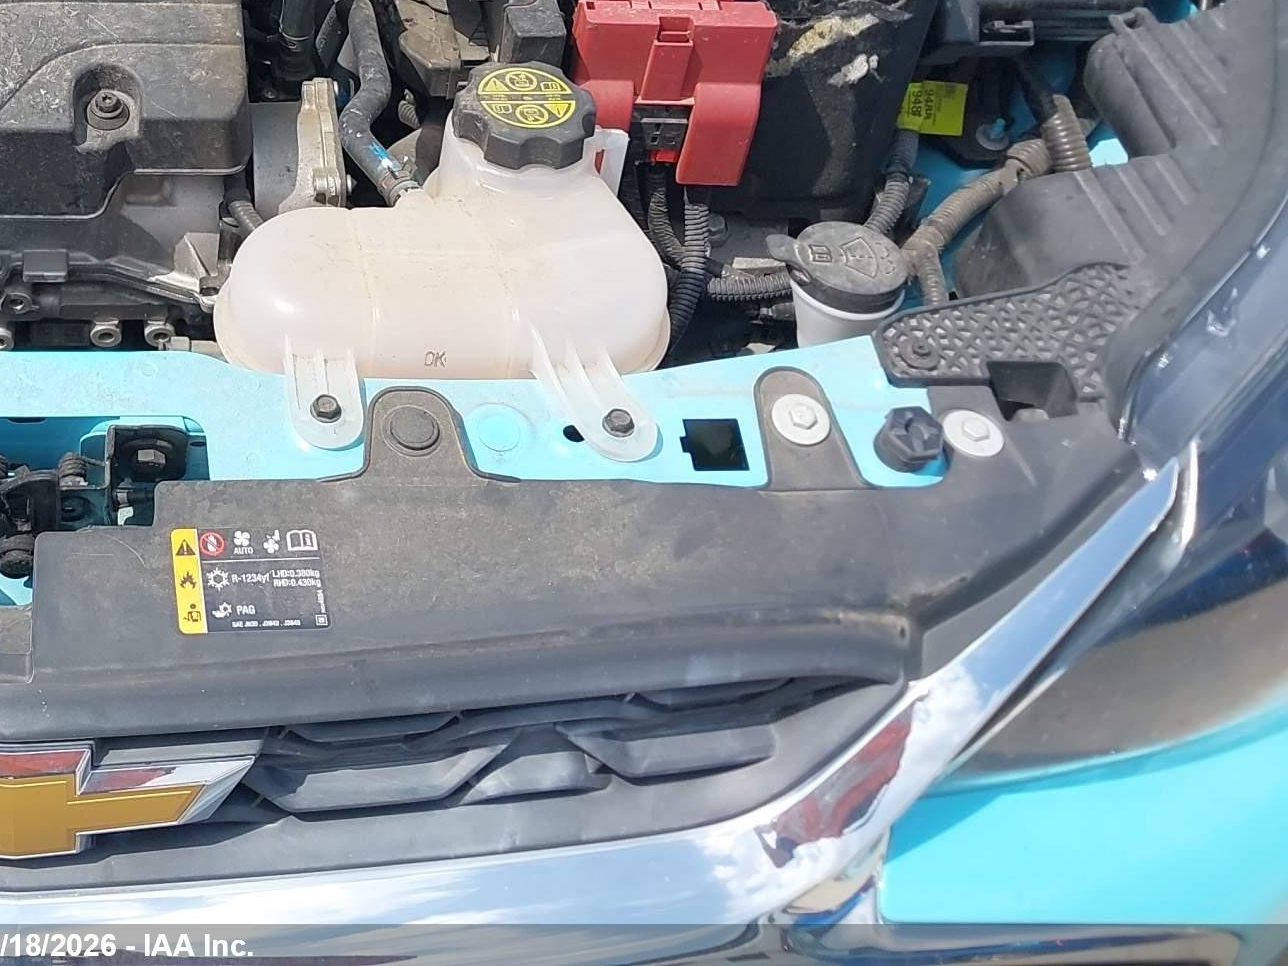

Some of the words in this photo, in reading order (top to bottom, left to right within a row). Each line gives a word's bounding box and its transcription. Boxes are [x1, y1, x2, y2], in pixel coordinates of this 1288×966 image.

[424, 350, 446, 368] OK
[233, 546, 254, 555] AUTO
[231, 572, 270, 585] R-1234yf
[235, 604, 256, 615] PAG
